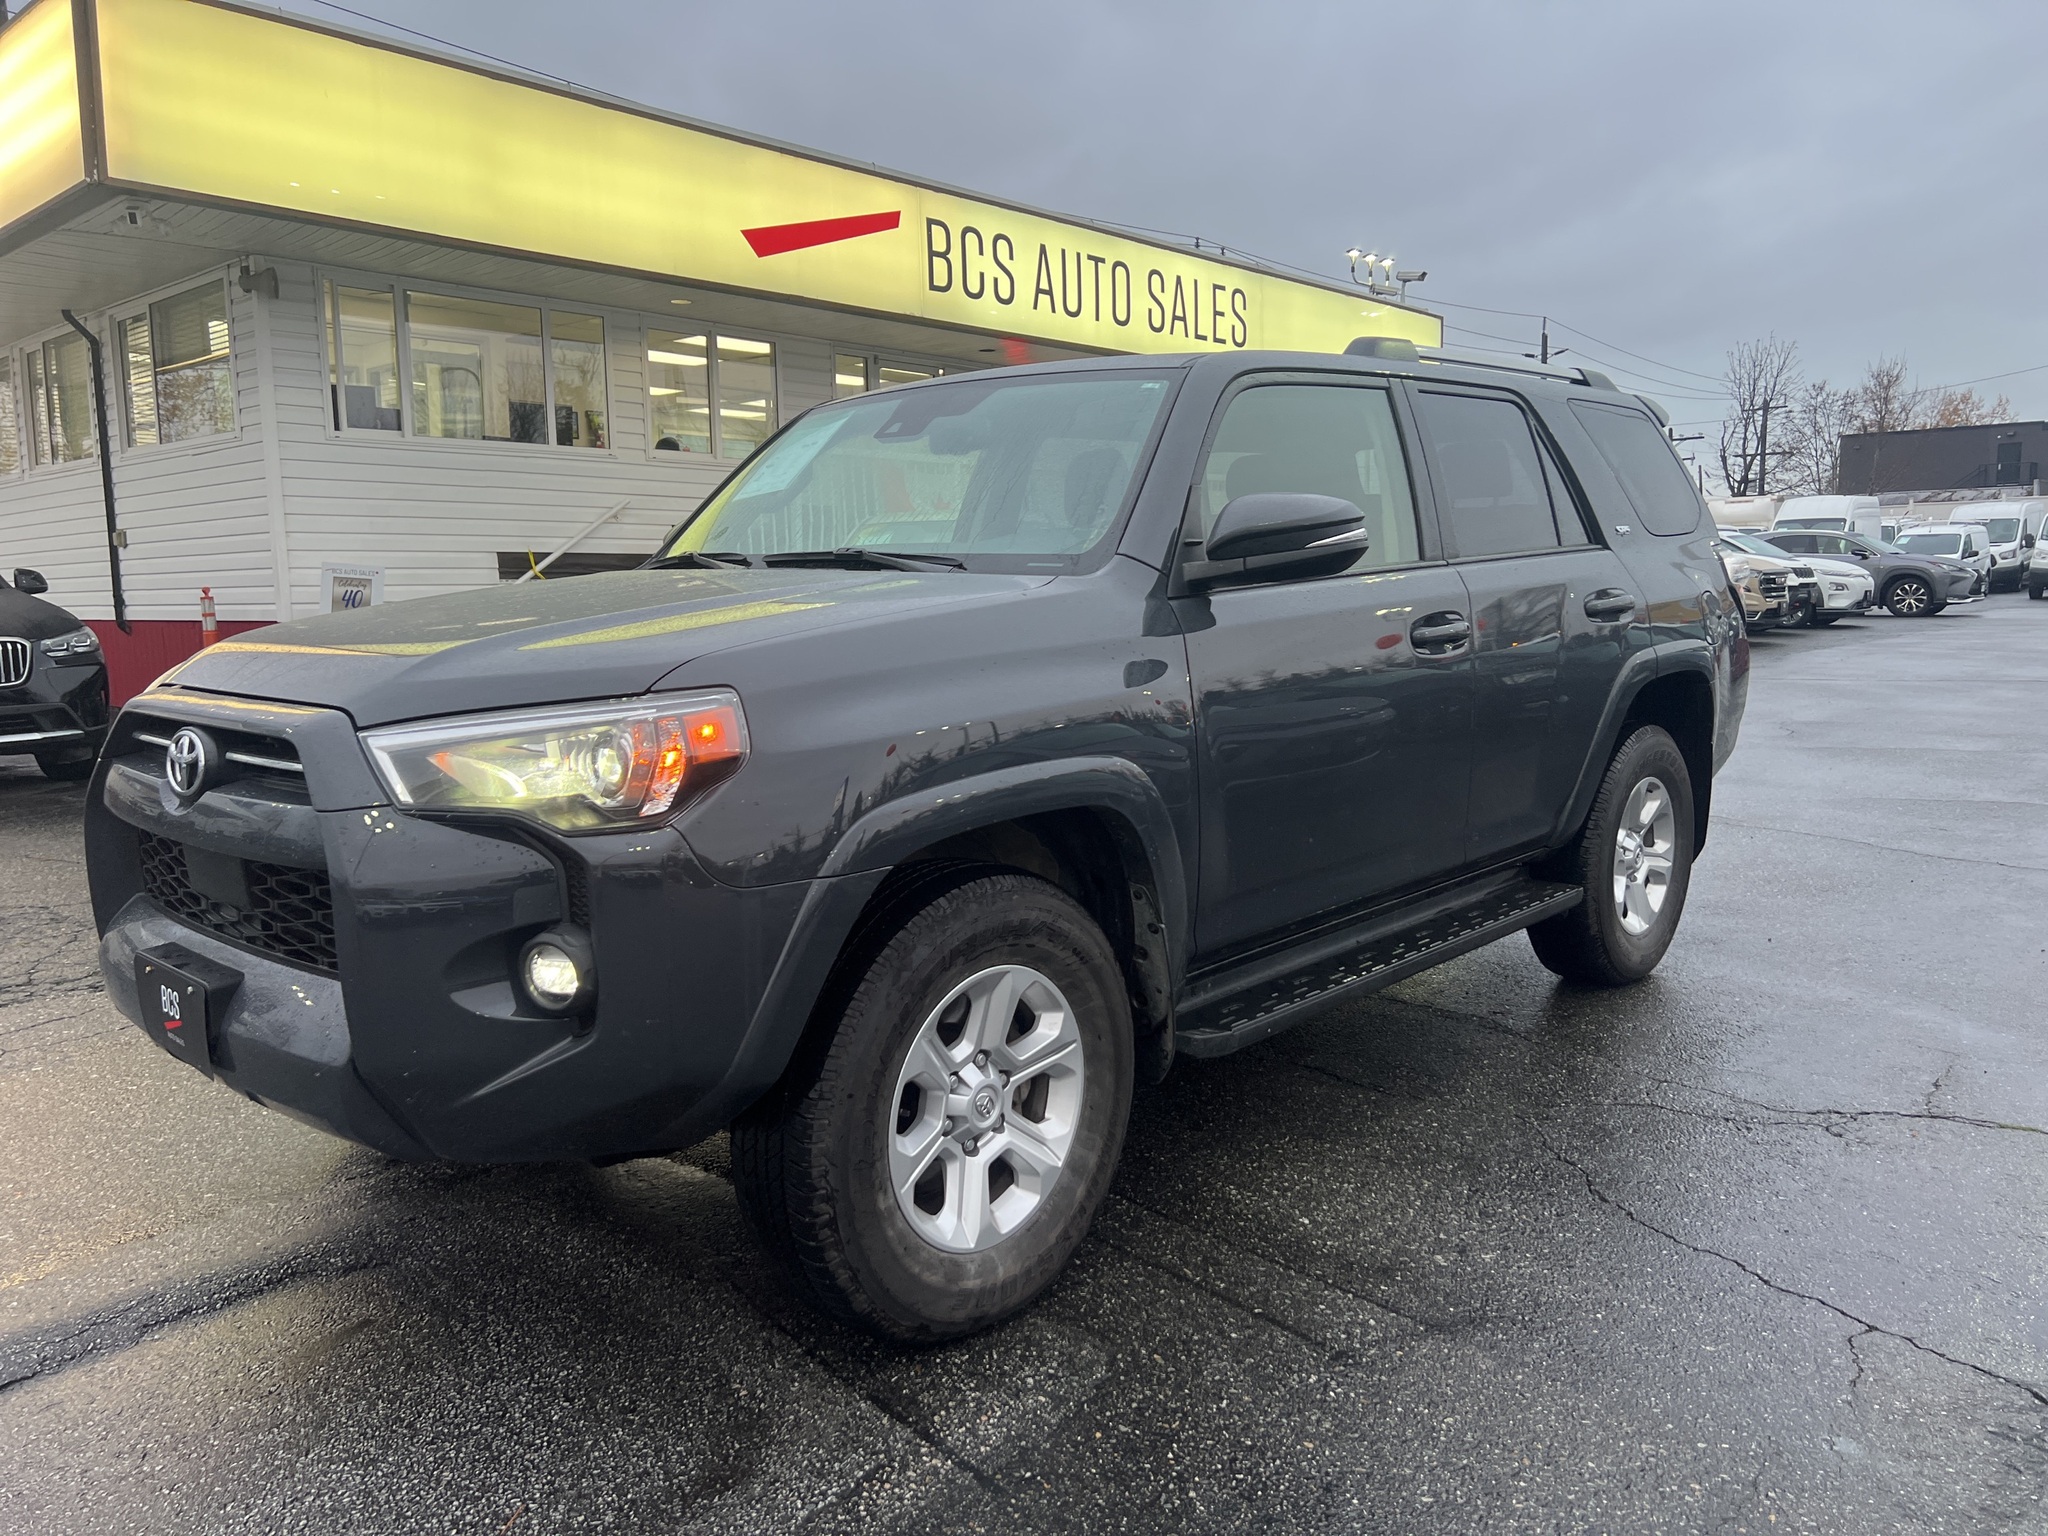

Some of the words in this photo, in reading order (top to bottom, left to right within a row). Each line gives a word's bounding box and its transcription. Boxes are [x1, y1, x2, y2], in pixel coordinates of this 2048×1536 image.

[926, 217, 1015, 306] BCS
[1033, 243, 1132, 327] AUTO
[1147, 269, 1247, 348] SALES
[332, 567, 342, 575] BCS
[344, 568, 357, 576] AUTO
[359, 569, 375, 577] SALES
[342, 589, 364, 608] 40
[161, 984, 180, 1020] BCS
